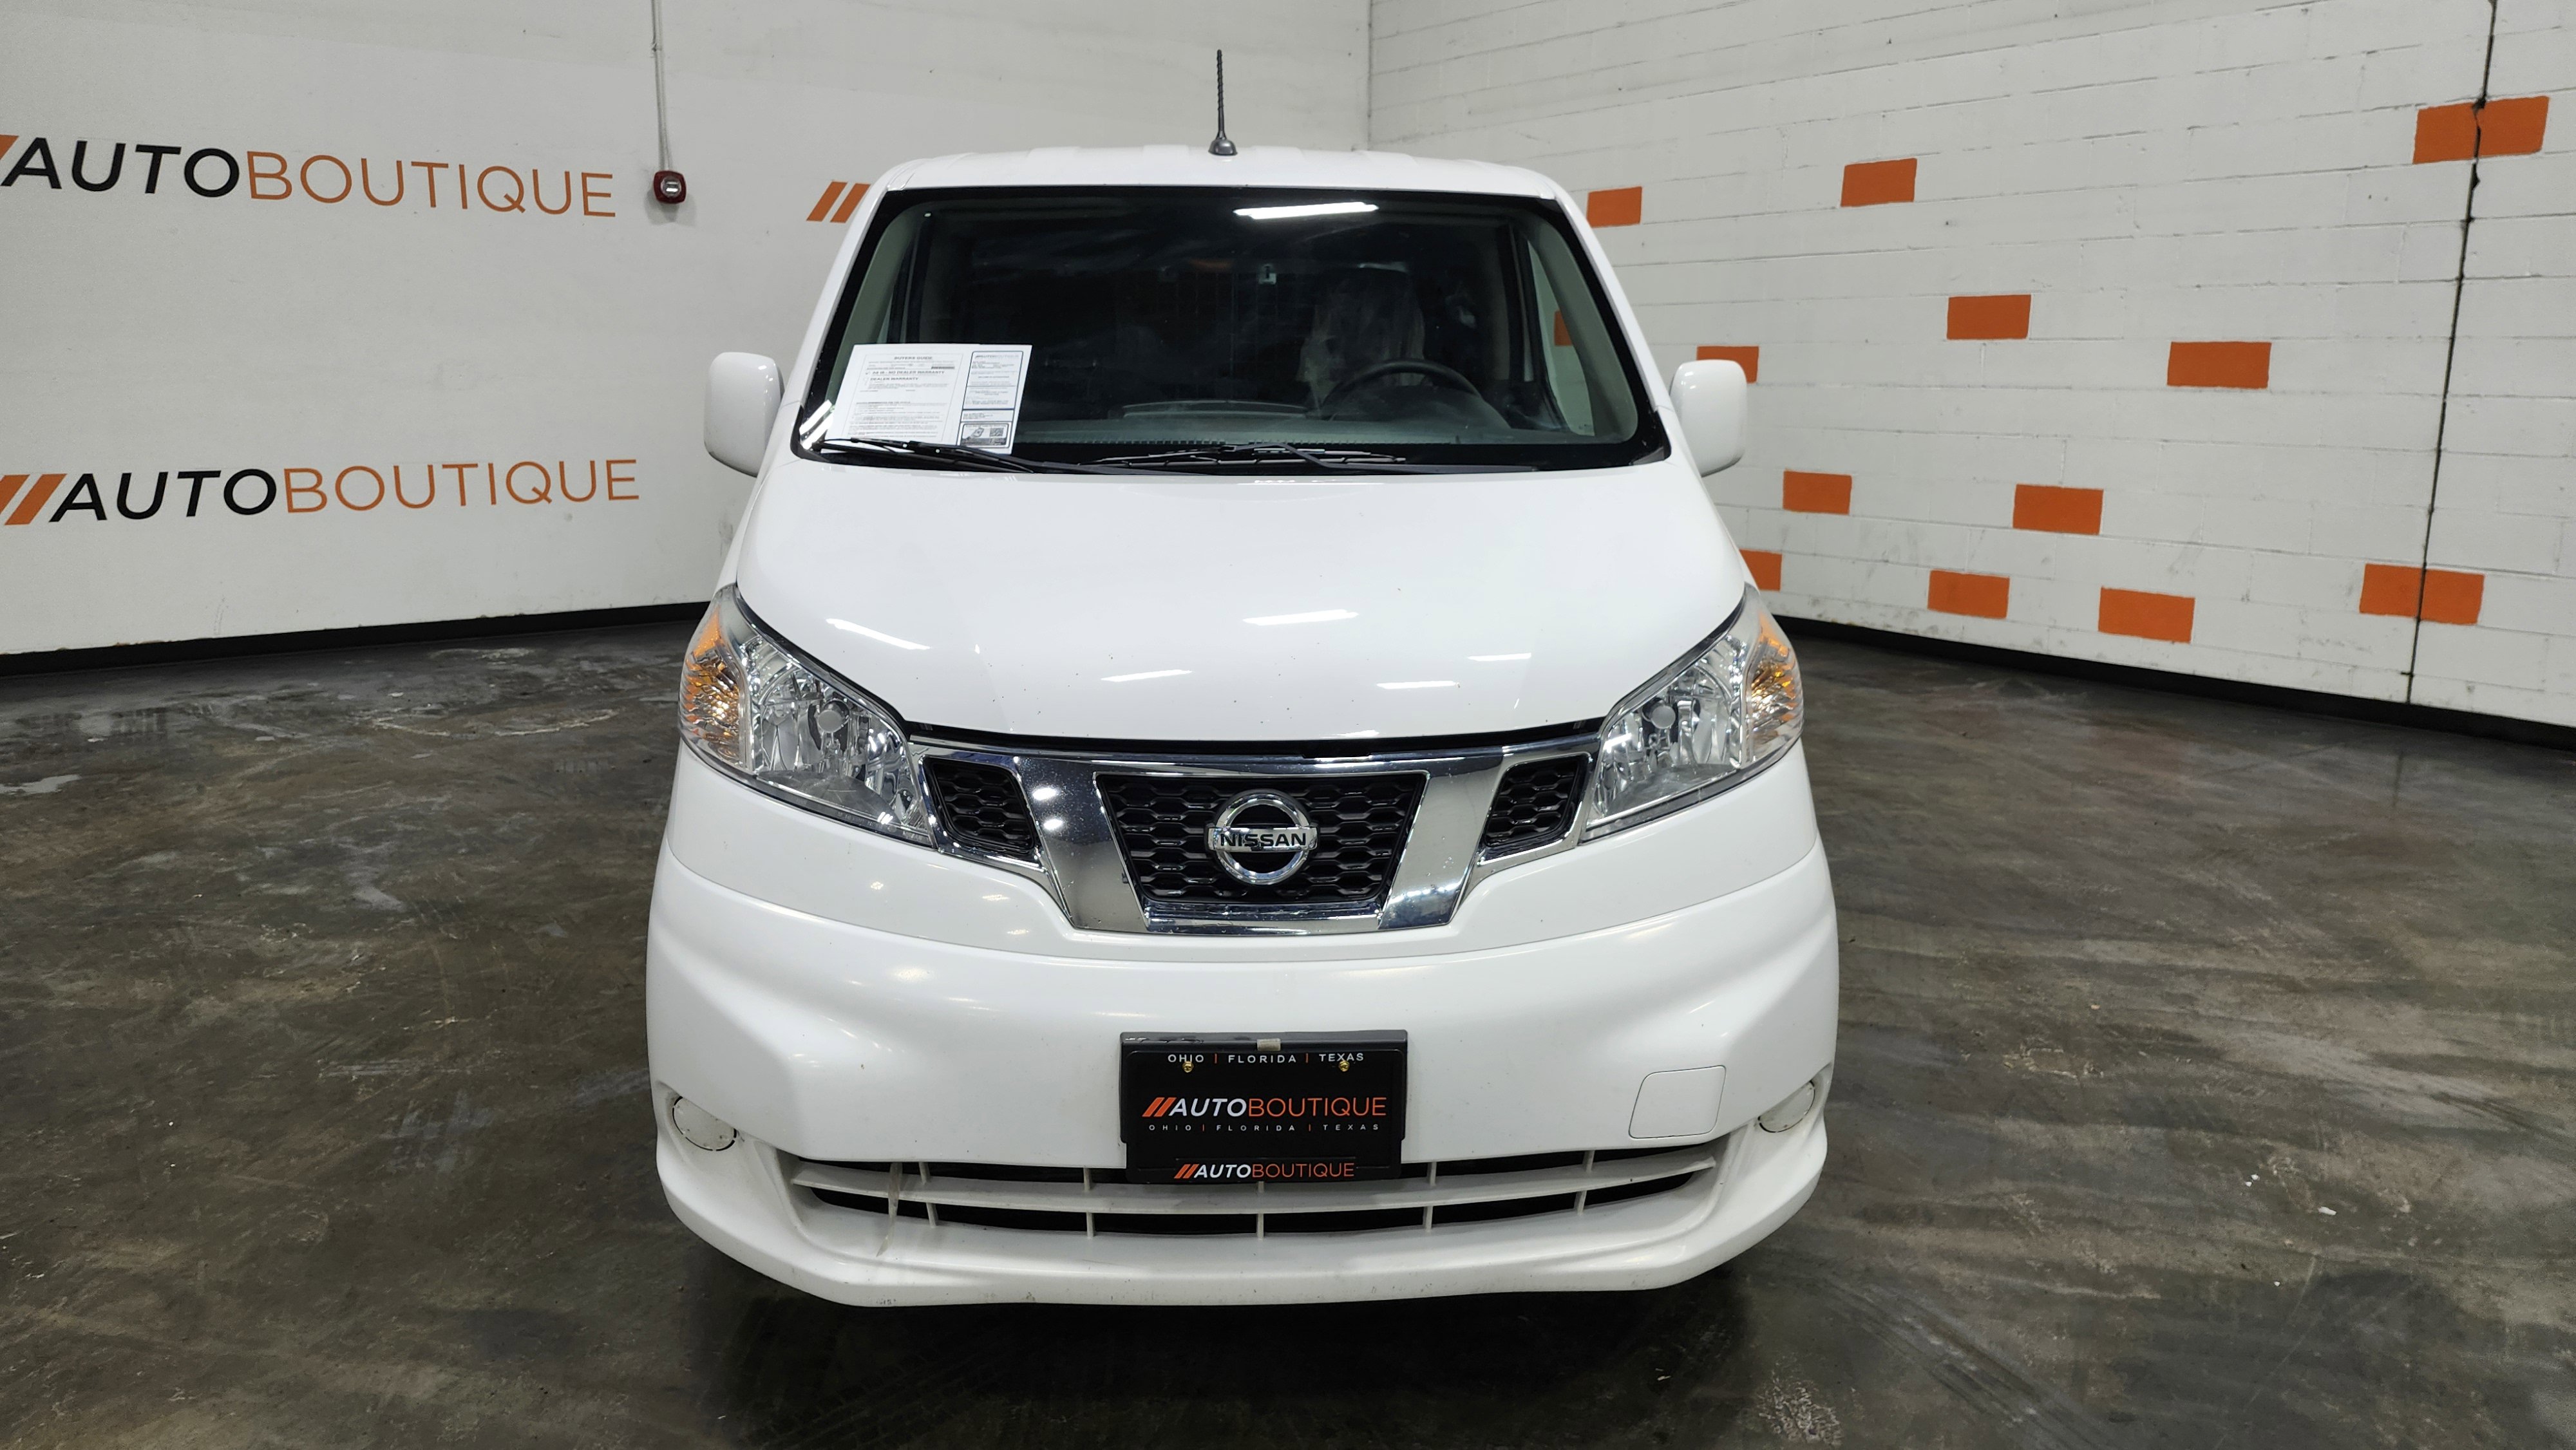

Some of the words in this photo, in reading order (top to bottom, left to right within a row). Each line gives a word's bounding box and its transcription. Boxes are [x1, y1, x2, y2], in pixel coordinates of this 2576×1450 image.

[1, 137, 616, 218] AUTOBOUTIQUE
[49, 459, 639, 523] AUTOBOUTIQUE
[1220, 833, 1307, 847] NISSAN
[1167, 1053, 1205, 1064] OHIO
[1227, 1053, 1296, 1064] FLORIDA
[1318, 1052, 1364, 1062] TEXAS
[1168, 1097, 1387, 1118] AUTOBOUTIQUE
[1193, 1162, 1355, 1179] AUTOBOUTIQUE
